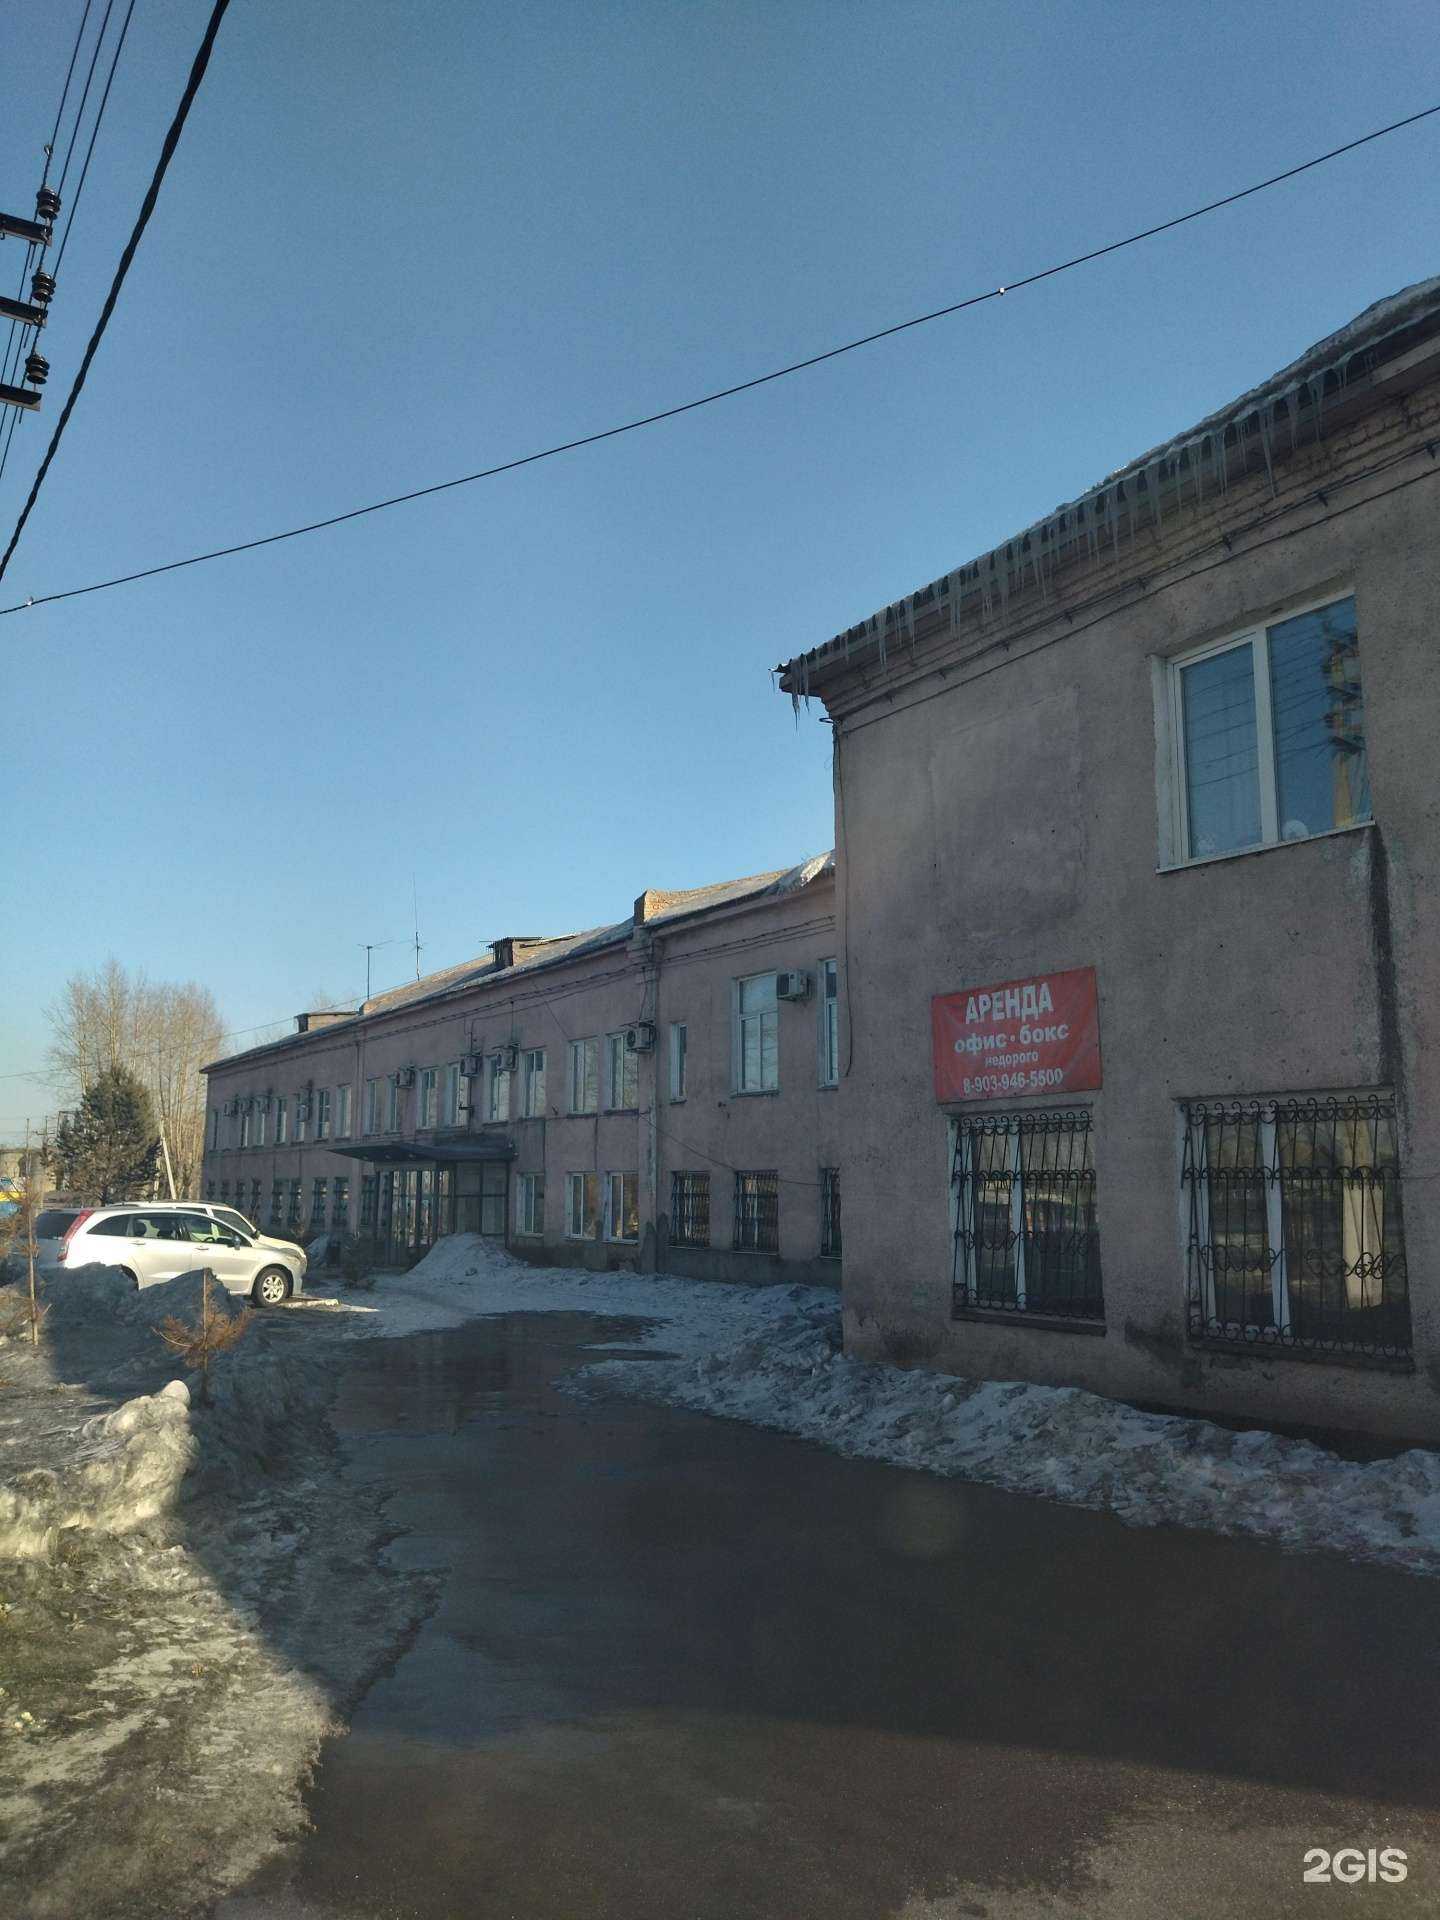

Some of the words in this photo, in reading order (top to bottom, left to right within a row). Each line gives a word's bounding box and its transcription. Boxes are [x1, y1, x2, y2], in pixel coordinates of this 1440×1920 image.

[965, 982, 1054, 1025] АРЕНДА
[954, 1032, 1007, 1054] офис
[1019, 1024, 1070, 1045] бокс
[985, 1050, 1039, 1067] недорого
[963, 1068, 1063, 1094] 8-903-946-5500
